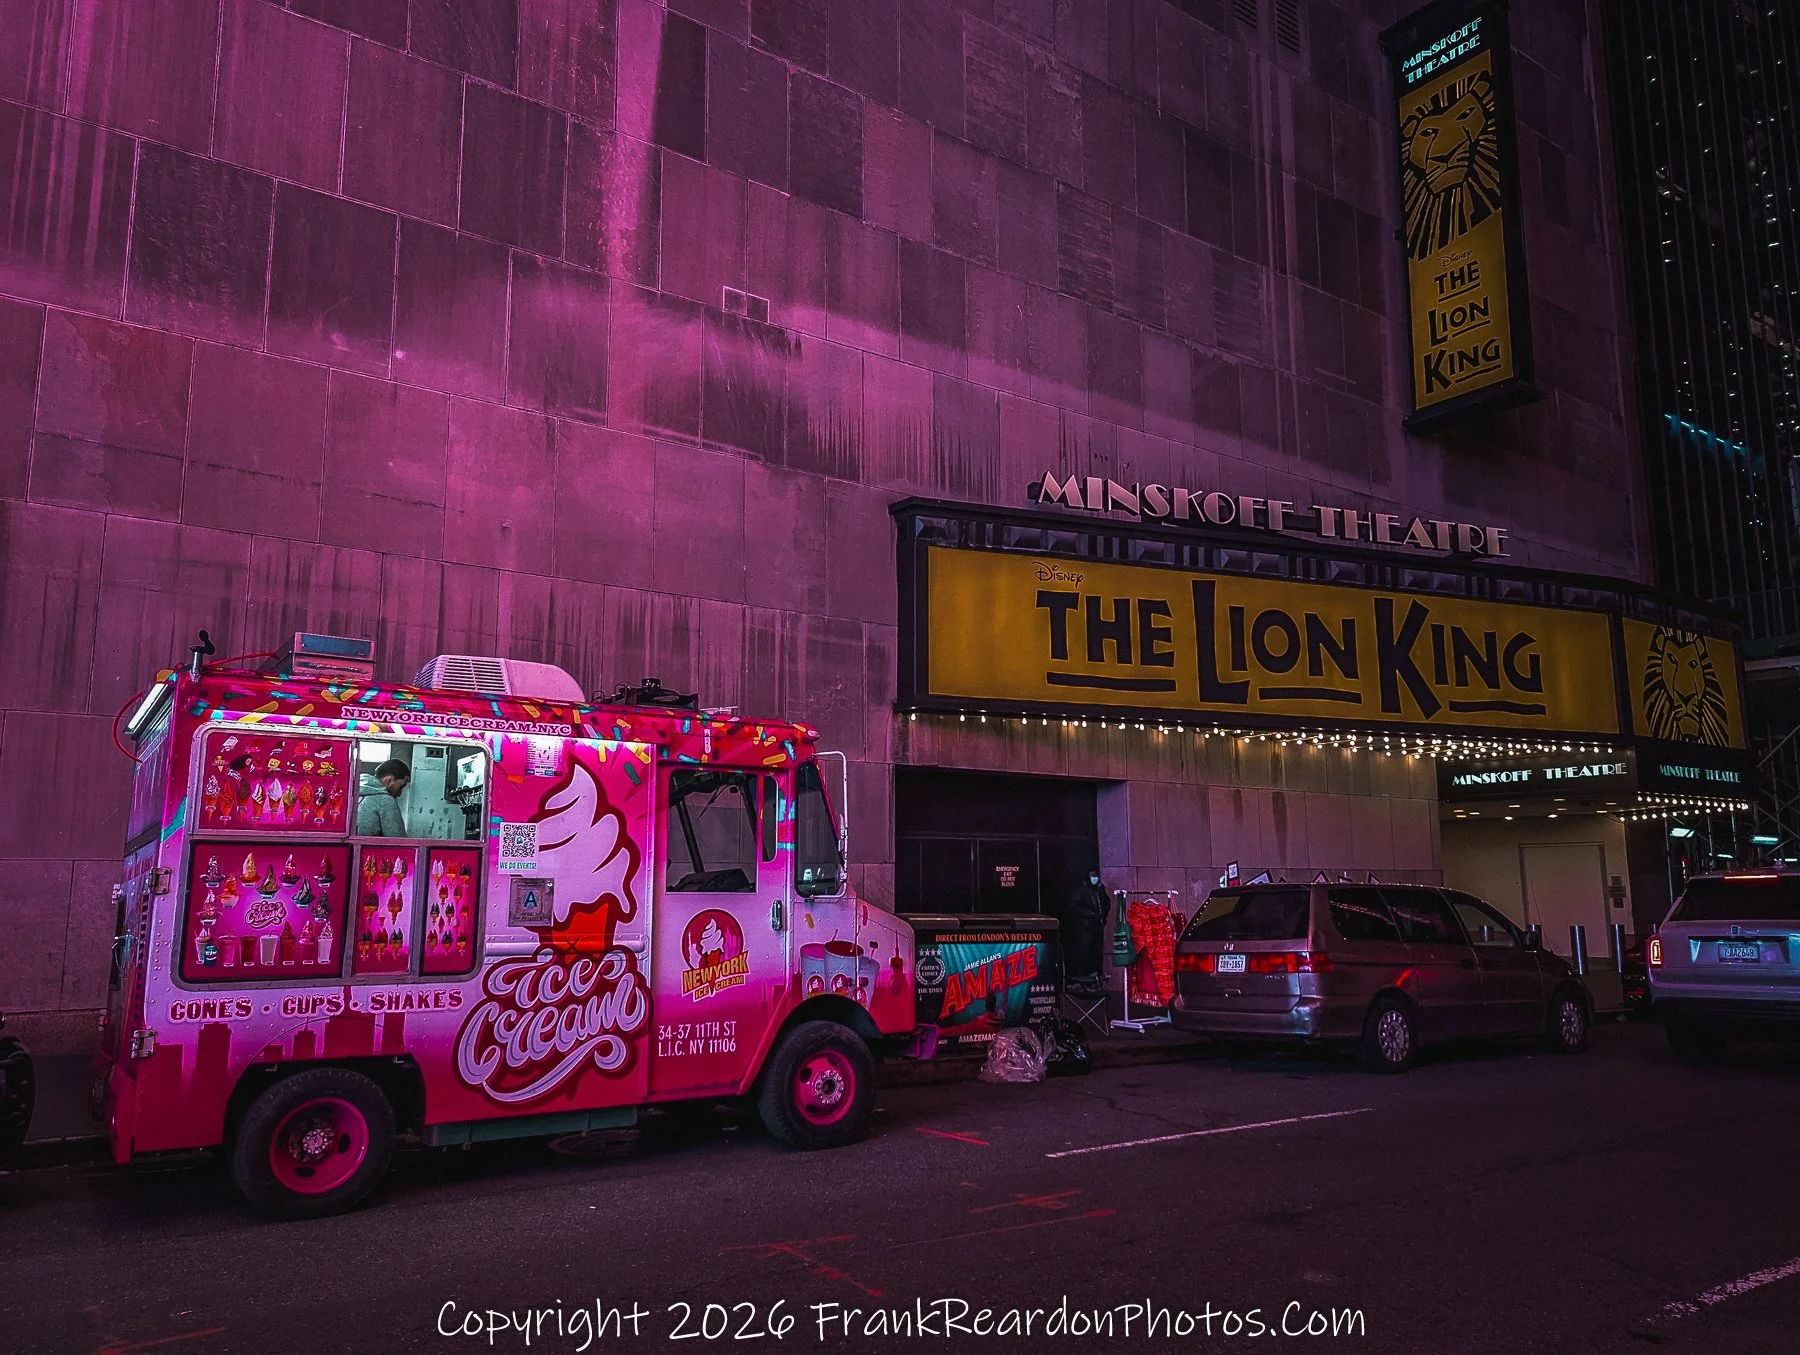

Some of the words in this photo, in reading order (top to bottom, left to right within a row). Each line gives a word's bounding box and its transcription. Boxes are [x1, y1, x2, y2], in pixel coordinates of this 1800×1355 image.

[1402, 16, 1482, 72] MINSKOFF
[1405, 34, 1480, 84] THEATRE
[1433, 260, 1480, 295] THE
[1038, 470, 1295, 531] MINSKOFF
[1313, 505, 1511, 557] THEATRE
[1035, 590, 1176, 667] THE
[342, 707, 572, 734] NEWYORKICECREAM.NYC
[1452, 769, 1532, 786] MINSKOFF
[1543, 763, 1628, 780] THEATRE
[1659, 764, 1700, 779] MINSKOFF
[1704, 768, 1741, 783] THEATRE
[499, 862, 507, 870] WE
[509, 862, 516, 870] DO
[517, 862, 537, 870] EVENTS!
[523, 890, 538, 908] A
[935, 934, 957, 942] DIRECT
[958, 934, 977, 942] FROM
[977, 933, 1009, 942] LONDON'S
[1010, 933, 1028, 941] WEST
[1028, 933, 1041, 941] END
[964, 961, 981, 971] JAMIE
[980, 953, 1002, 965] ALLAN'S
[487, 948, 627, 1009] Ice
[694, 986, 709, 1000] ICE
[715, 975, 744, 991] CREAM
[938, 946, 1039, 1020] AMAZE
[170, 997, 252, 1021] CONES
[282, 994, 343, 1016] CUPS
[370, 988, 464, 1011] SHAKES
[457, 973, 646, 1102] Cream
[658, 1024, 691, 1040] 34-37
[695, 1021, 720, 1038] 11TH
[724, 1020, 737, 1036] ST
[658, 1040, 685, 1057] L.I.C.
[689, 1039, 705, 1055] NY
[708, 1037, 736, 1053] 11106
